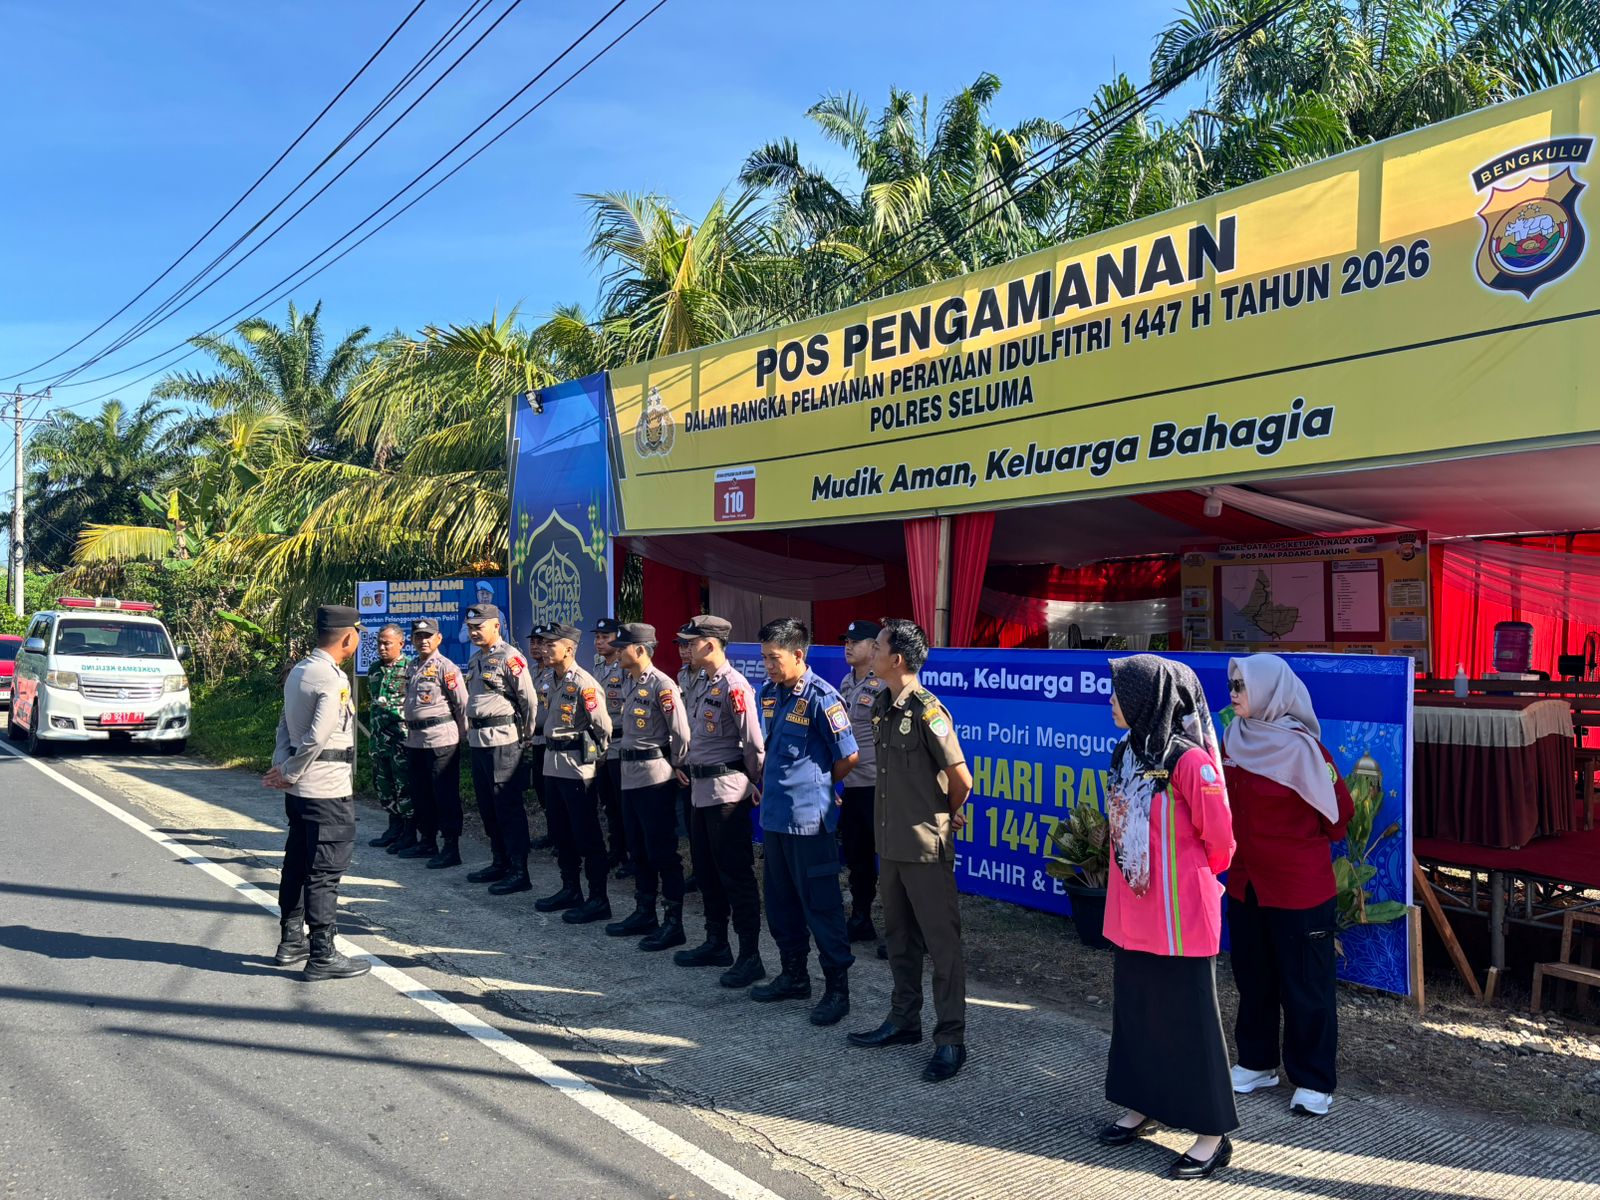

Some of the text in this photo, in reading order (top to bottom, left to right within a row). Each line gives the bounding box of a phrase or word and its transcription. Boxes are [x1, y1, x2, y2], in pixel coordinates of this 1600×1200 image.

[1481, 145, 1583, 183] BENGKULU
[755, 215, 1237, 388] POS PENGAMANAN
[685, 238, 1431, 433] DALAM RANGKA PELAYANAN PERAYAAN IDULFITRI 1447 H TAHUN 2026
[870, 374, 1034, 432] POLRES SELUMA
[810, 397, 1336, 501] Mudik Aman, Keluarga Bahagia
[723, 490, 744, 513] 110
[1277, 550, 1312, 558] PADANG
[1314, 547, 1350, 556] BAKUNG
[1287, 540, 1324, 549] KETUPAT
[1353, 536, 1374, 544] 2026
[389, 580, 464, 592] BANTU KAMI
[389, 592, 441, 603] MENJADI
[425, 602, 459, 612] BAIK!
[921, 669, 968, 689] man,
[974, 667, 1073, 699] Keluarga
[988, 721, 1029, 745] Polri
[1036, 726, 1118, 757] Menguc
[973, 755, 1043, 804] HARI
[985, 806, 1060, 857] 1447
[968, 856, 1025, 887] LAHIR
[1032, 869, 1046, 892] &
